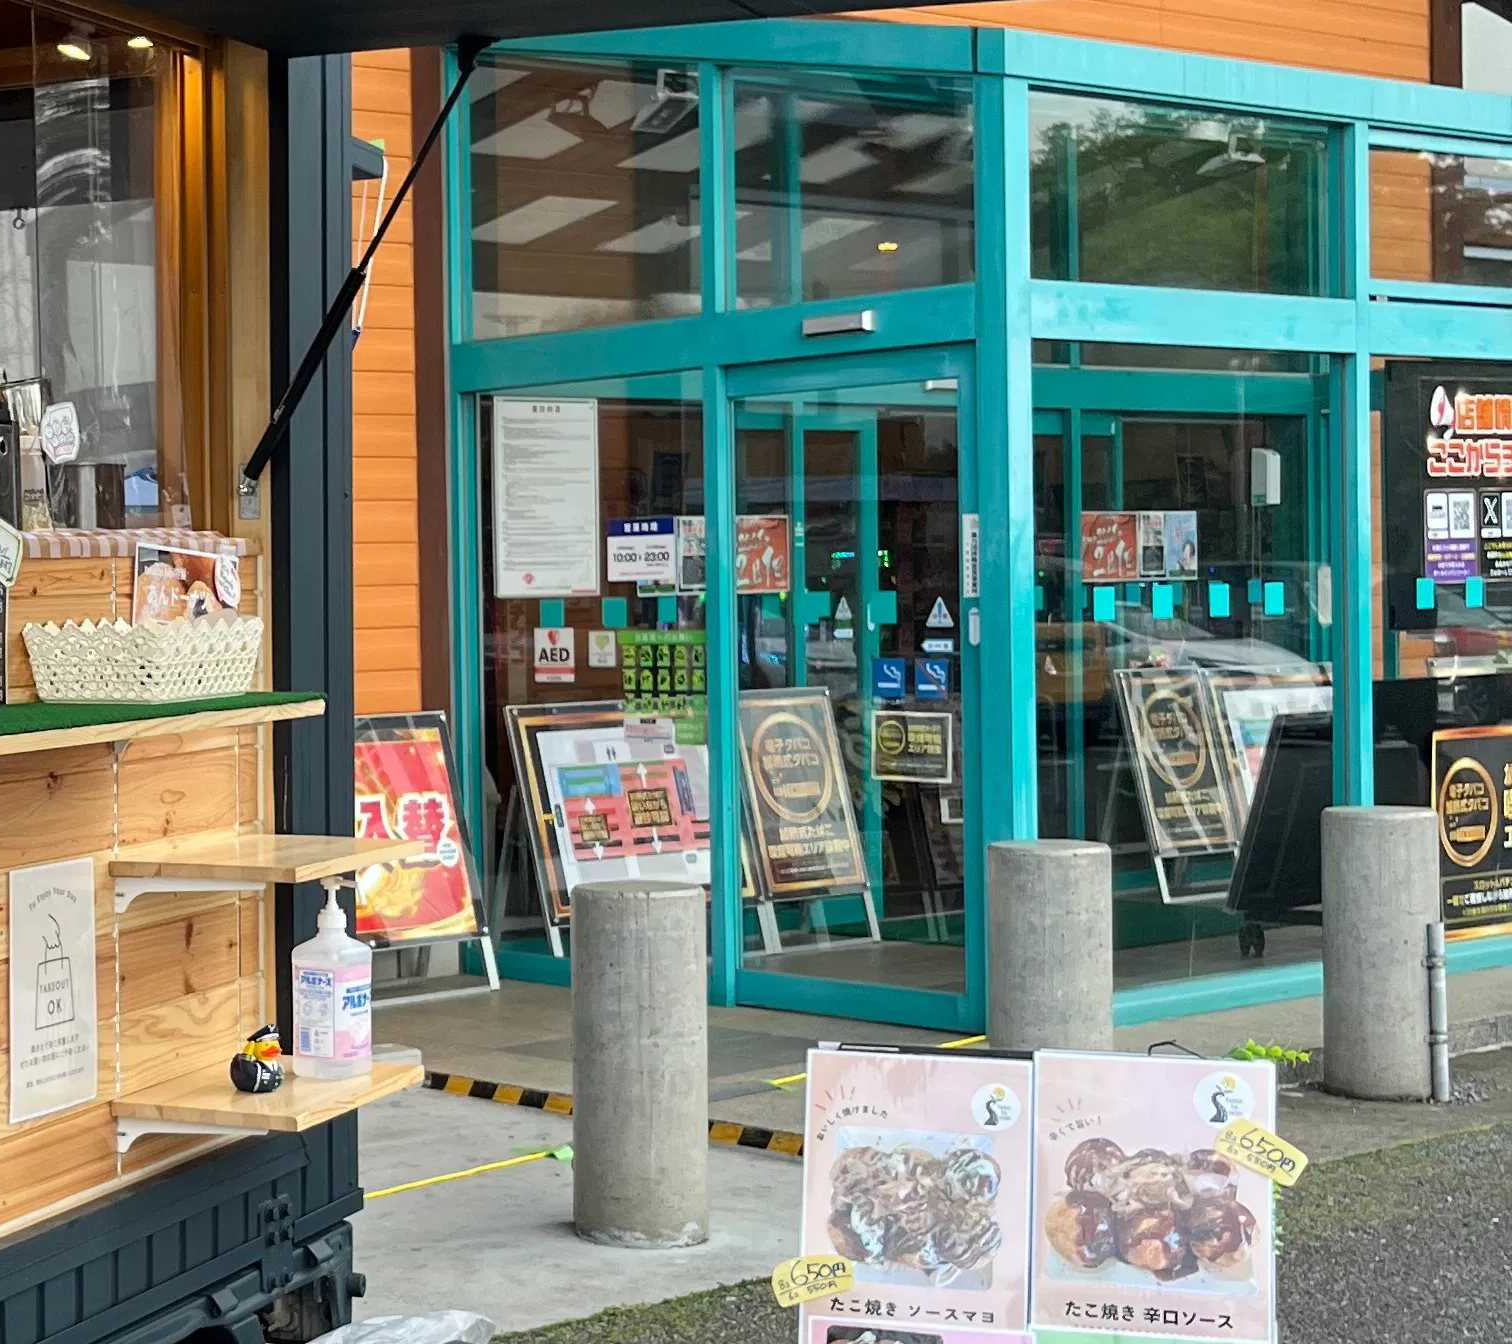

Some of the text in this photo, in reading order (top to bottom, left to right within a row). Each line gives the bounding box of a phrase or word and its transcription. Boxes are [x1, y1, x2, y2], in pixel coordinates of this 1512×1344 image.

[613, 551, 669, 563] 10:00 23:00
[538, 647, 570, 663] AED
[39, 978, 70, 994] TAKEOUT
[47, 997, 63, 1016] OK
[816, 1105, 888, 1142] おいしく焼けました
[1238, 1127, 1297, 1174] 650円
[789, 1259, 847, 1286] 650円
[806, 1280, 838, 1296] 550円
[830, 1296, 995, 1324] たこ焼き ソースマヨ
[1065, 1299, 1234, 1330] たこ焼き 辛口ソース
